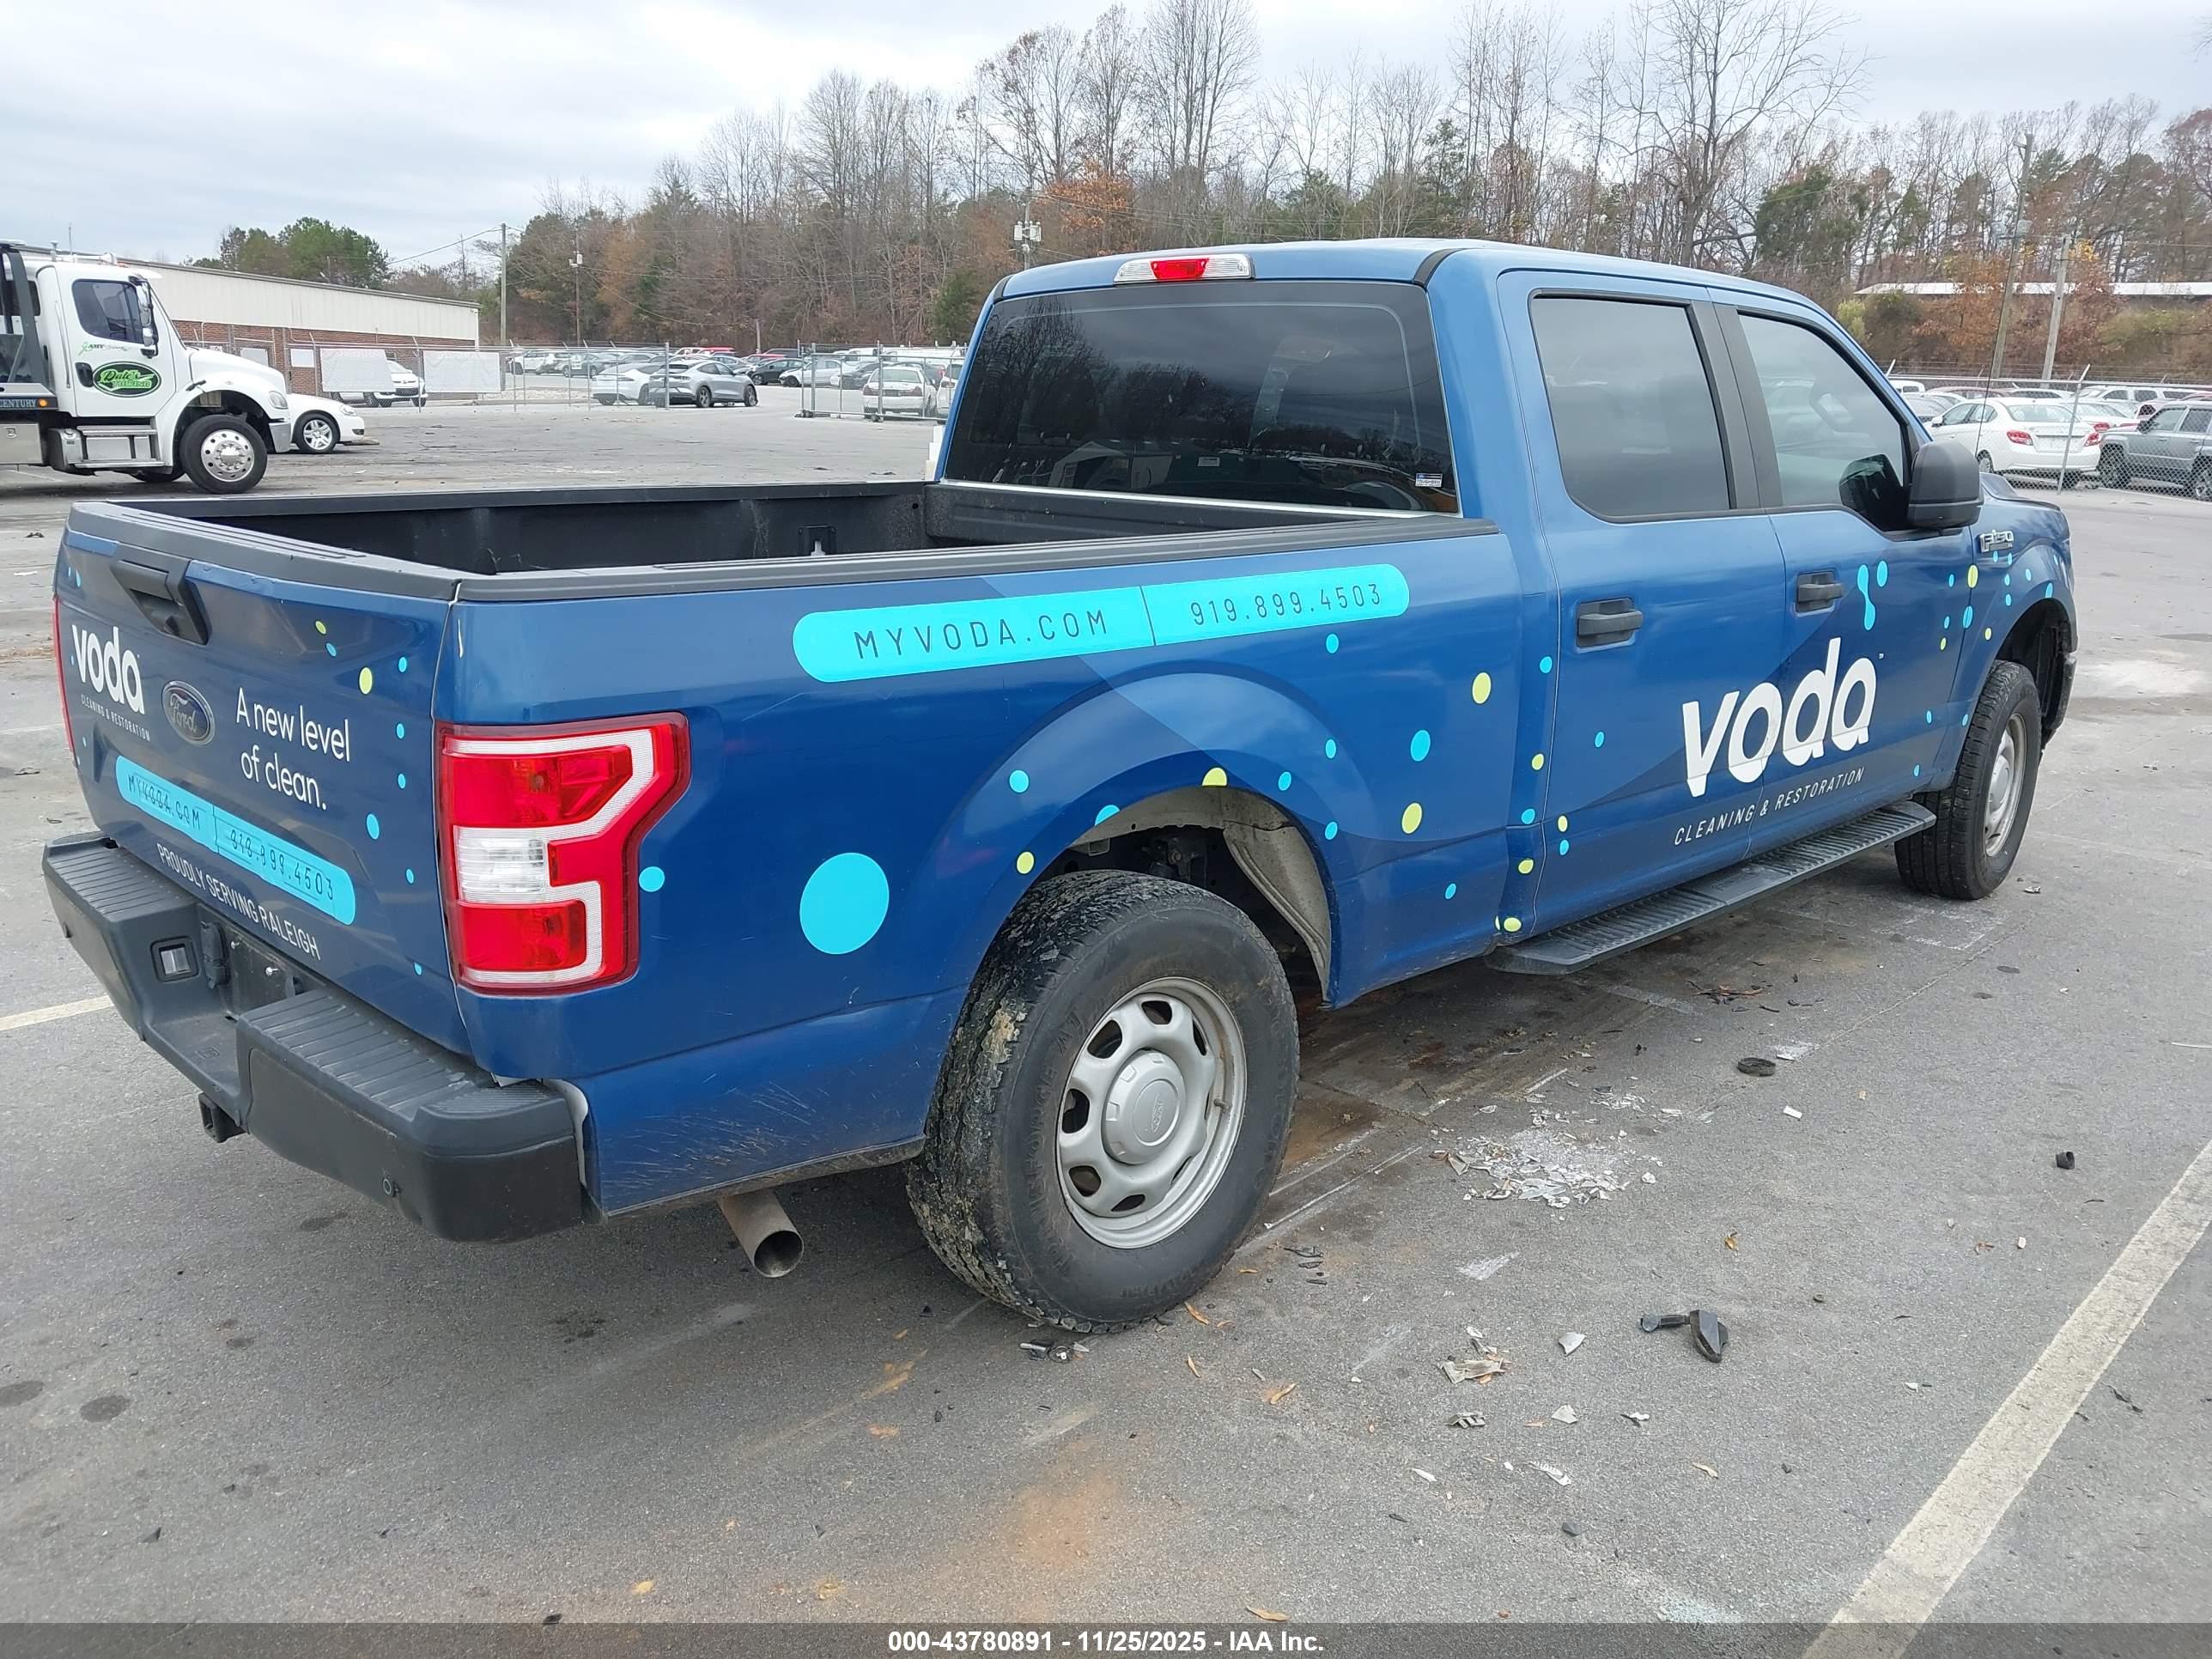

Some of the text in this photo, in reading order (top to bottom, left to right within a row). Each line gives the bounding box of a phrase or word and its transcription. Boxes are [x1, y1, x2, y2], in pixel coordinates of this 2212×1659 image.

[854, 583, 1382, 660] MYVODA.COM 919.899.4503
[71, 624, 145, 714] voda
[81, 694, 105, 717] CLEANING
[111, 712, 151, 742] RESTORATION
[170, 693, 198, 732] Ford
[236, 687, 350, 762] A new level
[1682, 637, 1876, 797] voda
[240, 744, 327, 810] of clean.
[1674, 767, 1865, 846] CLEANING & RESTORATION
[156, 842, 321, 961] PROUDLY SERVING RALEIGH
